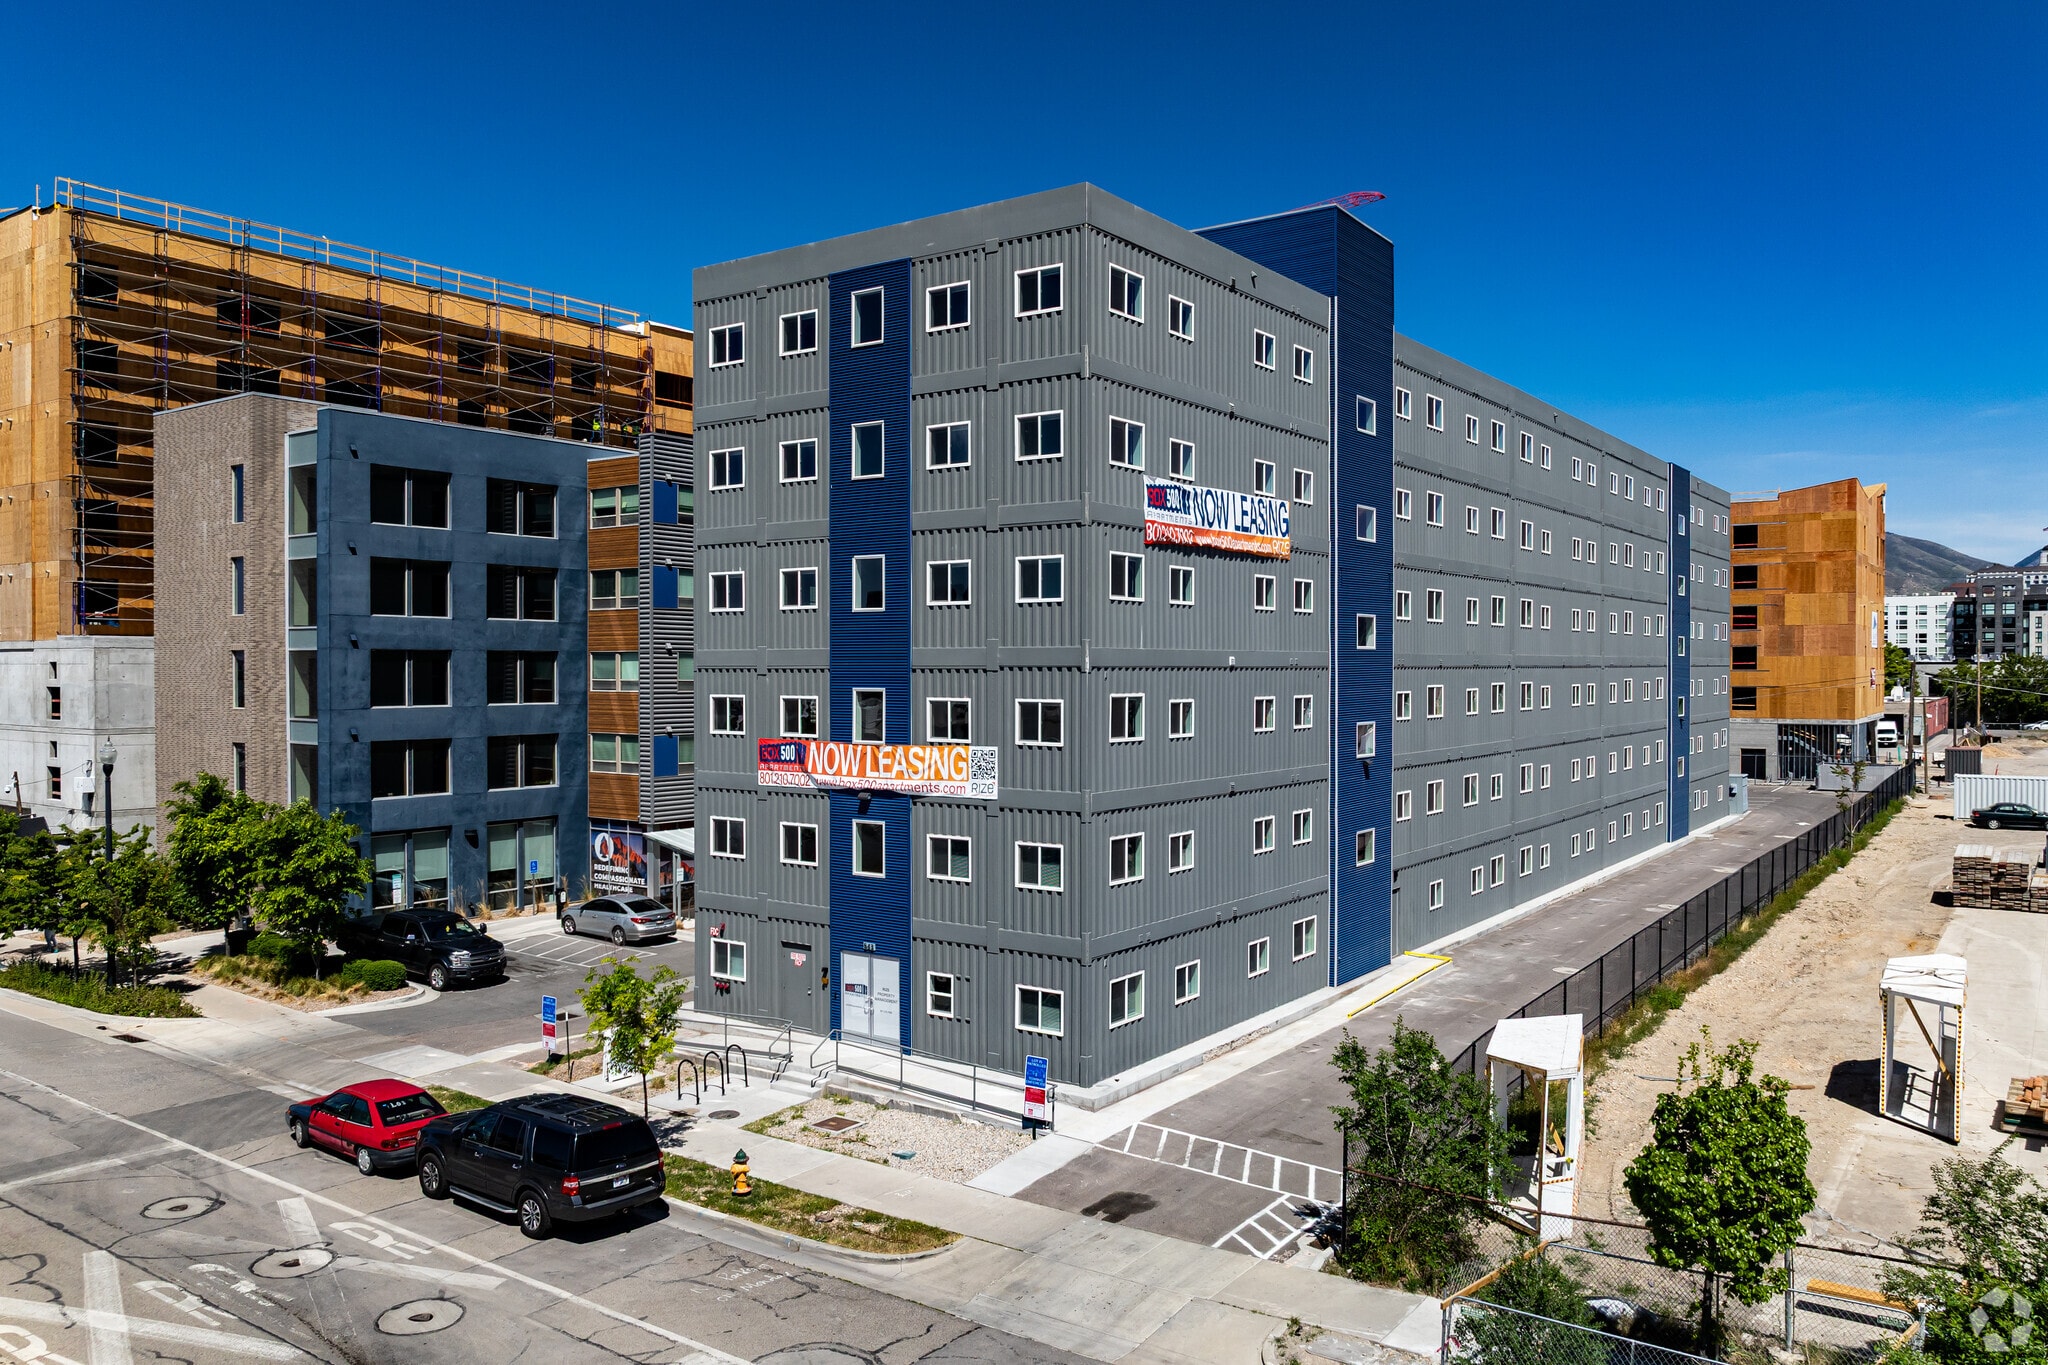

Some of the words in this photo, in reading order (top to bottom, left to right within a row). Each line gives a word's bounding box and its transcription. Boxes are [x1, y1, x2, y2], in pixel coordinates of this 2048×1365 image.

[1193, 487, 1230, 529] NOW
[1233, 493, 1289, 537] LEASING
[761, 746, 780, 760] BOX
[780, 744, 796, 761] 500
[808, 742, 863, 777] NOW
[865, 745, 968, 781] LEASING
[593, 872, 646, 885] COMPASSIONATE
[593, 882, 634, 893] HEALTHCARE
